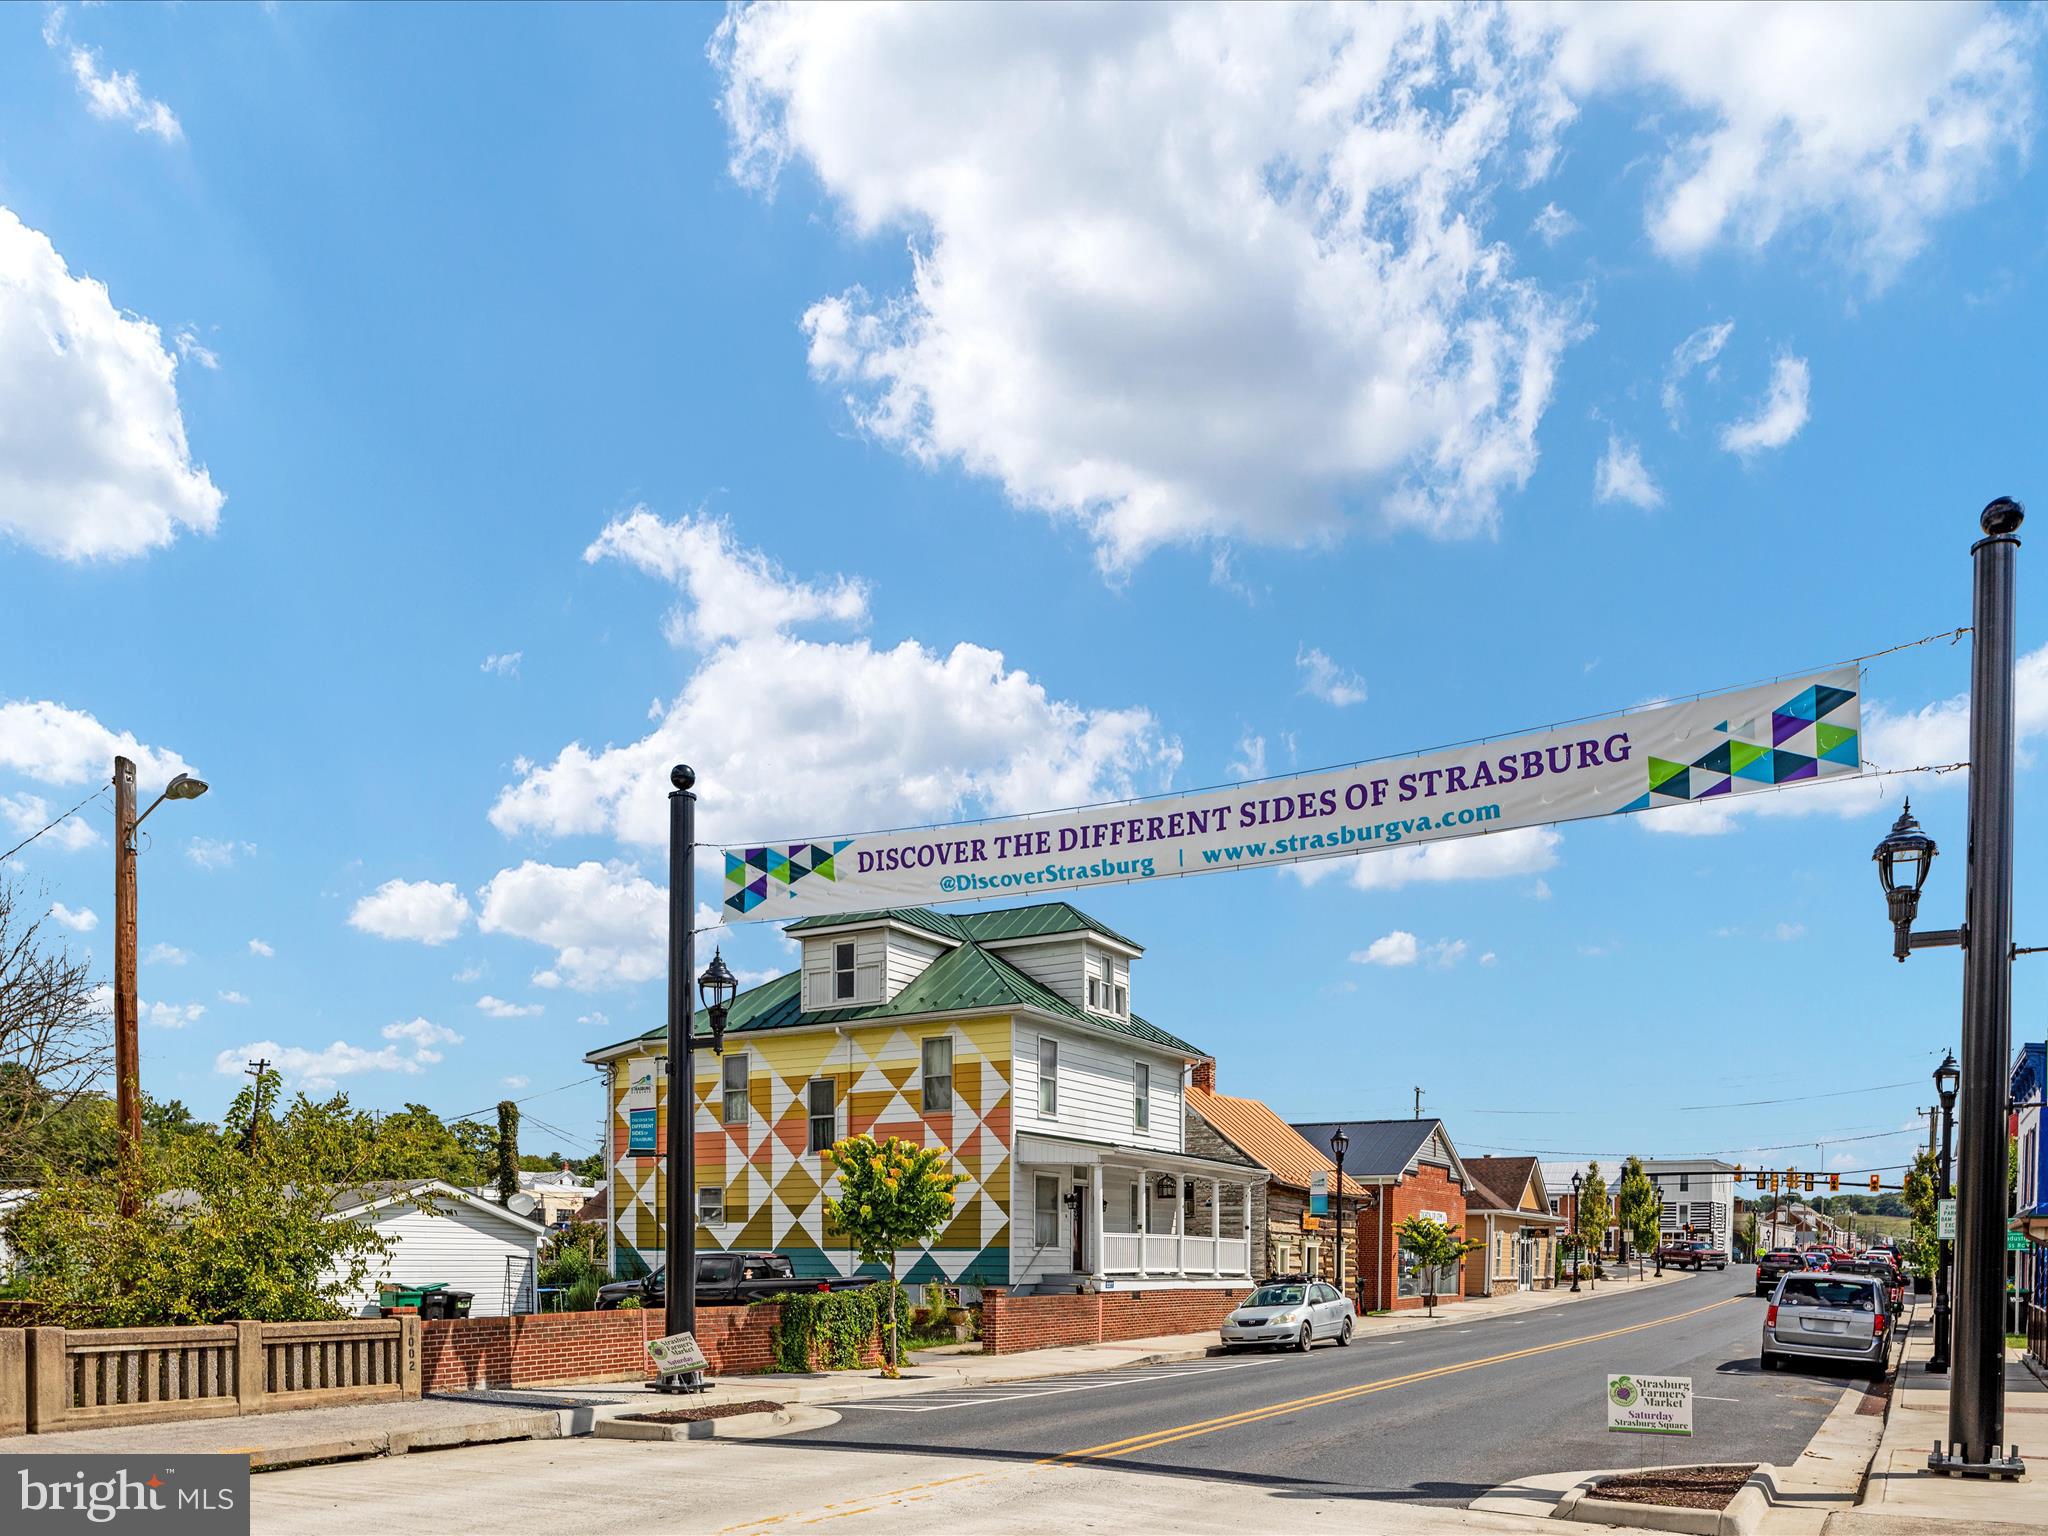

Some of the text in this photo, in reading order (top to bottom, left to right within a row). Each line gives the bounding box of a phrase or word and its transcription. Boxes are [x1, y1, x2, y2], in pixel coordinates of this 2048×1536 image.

[858, 732, 1632, 875] DISCOVER THE DIFFERENT SIDES OF STRASBURG
[940, 856, 1155, 893] @DiscoverStrasburg
[1202, 803, 1501, 864] www.strasburgva.com
[660, 1336, 692, 1346] Strasburg
[666, 1341, 694, 1351] Farmers
[670, 1347, 694, 1356] Market
[667, 1356, 694, 1365] Saturday
[1636, 1379, 1690, 1391] Strasburg
[1640, 1388, 1686, 1399] Farmers
[1644, 1397, 1683, 1408] Market
[1628, 1410, 1674, 1422] Saturday
[1614, 1418, 1689, 1430] Strasburg Square
